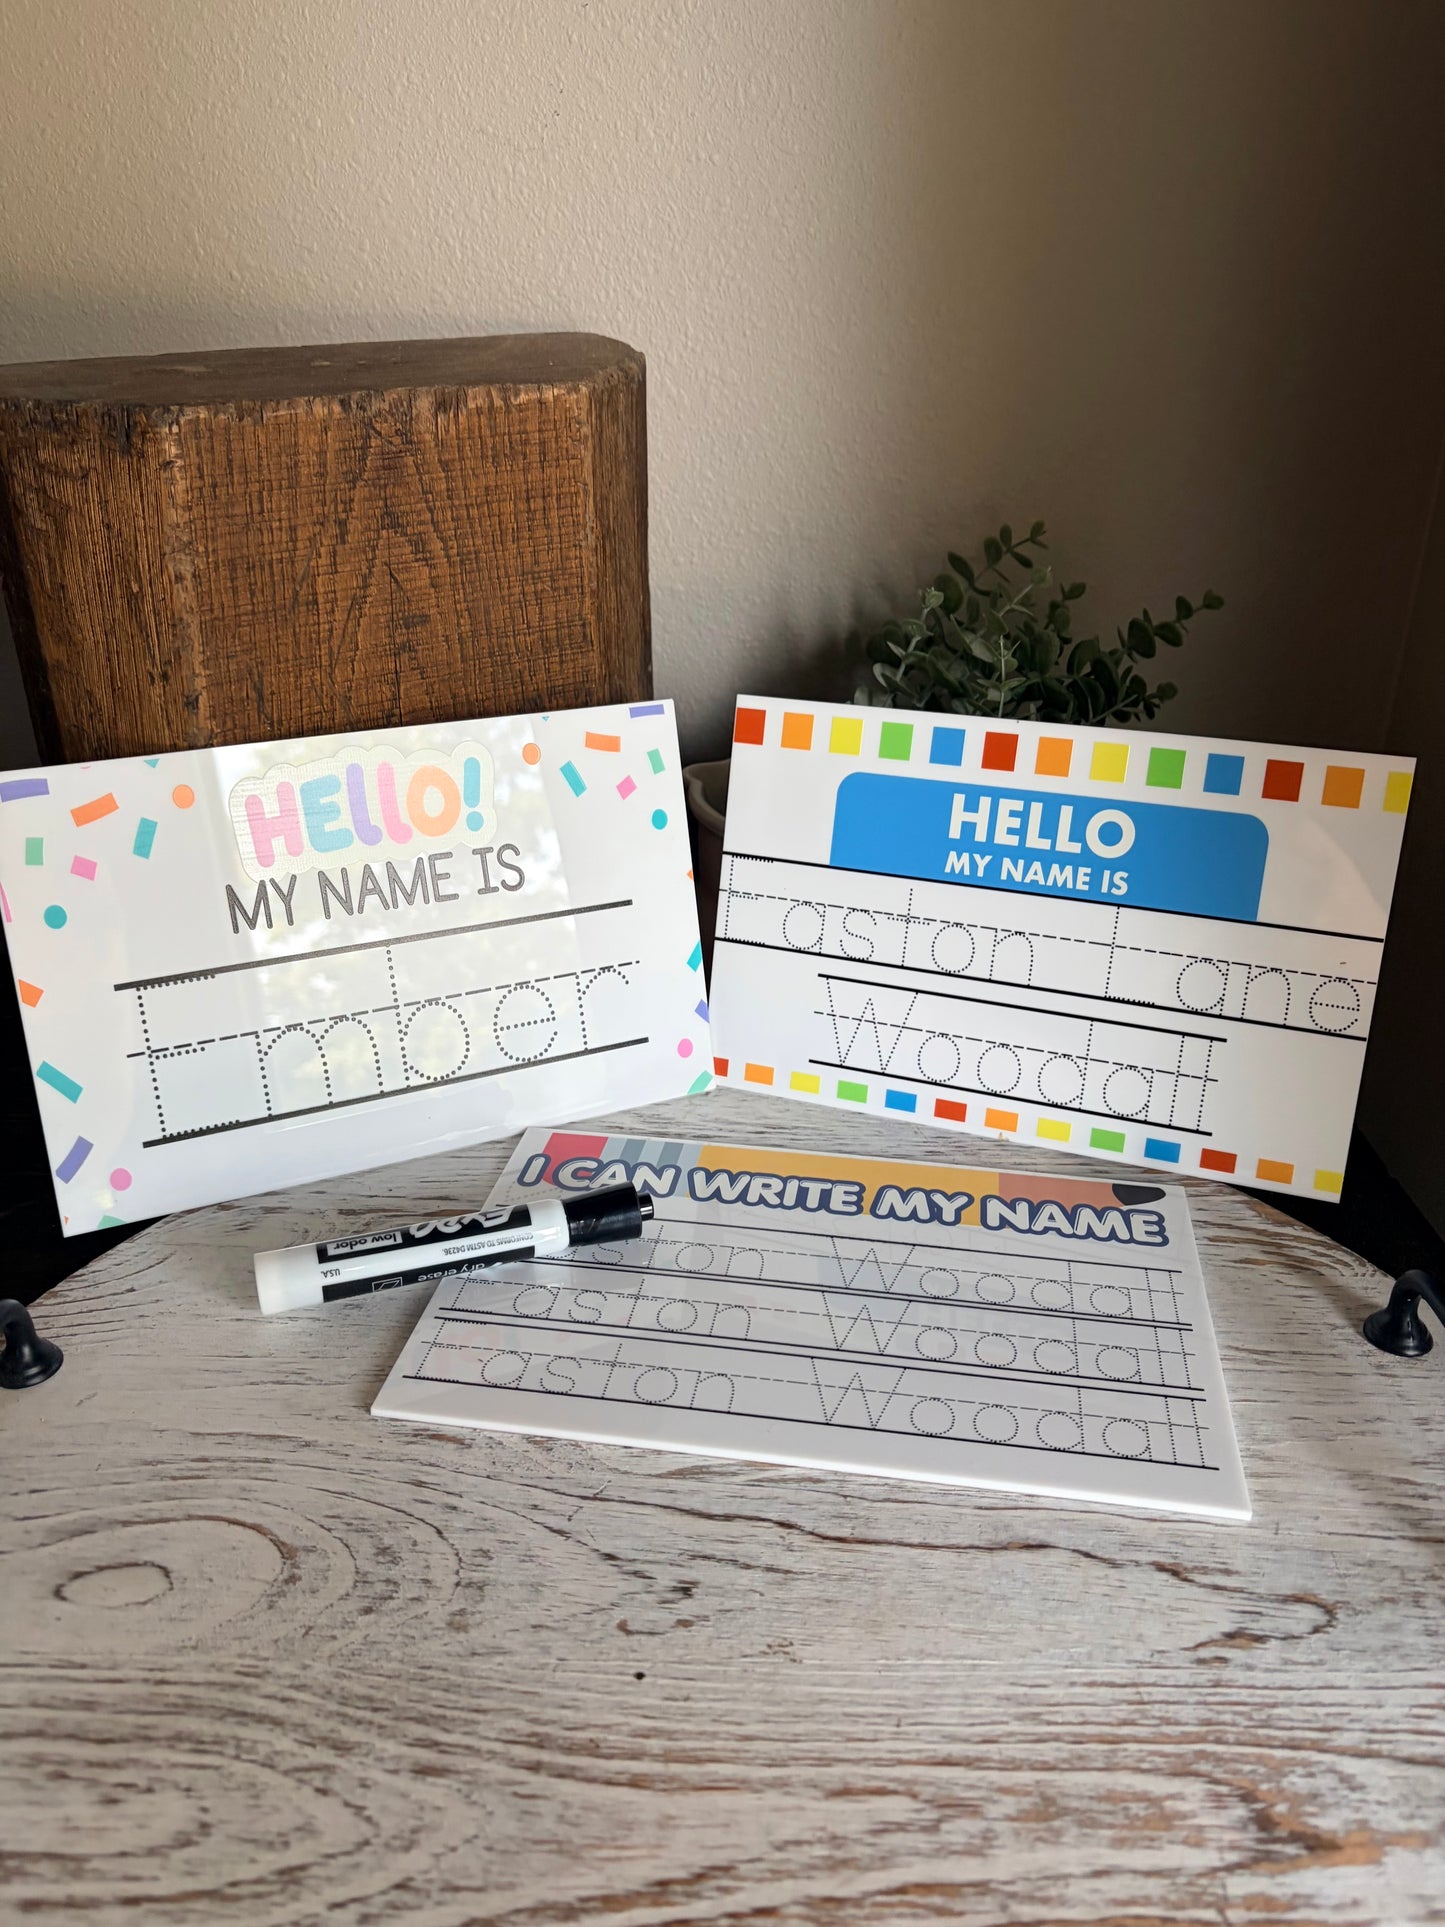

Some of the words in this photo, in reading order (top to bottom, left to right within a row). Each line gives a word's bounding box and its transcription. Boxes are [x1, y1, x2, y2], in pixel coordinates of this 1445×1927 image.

[948, 793, 1136, 858] HELLO
[225, 874, 297, 934] MY
[317, 851, 459, 919] NAME
[472, 843, 525, 895] IS
[944, 851, 993, 877] MY
[1000, 857, 1092, 891] NAME
[1101, 869, 1129, 896] IS
[724, 853, 1034, 986] Easton
[1104, 907, 1361, 1032] Lane
[136, 943, 630, 1138] Ember
[826, 976, 1213, 1133] Woodall
[333, 1238, 368, 1250] odor
[371, 1232, 397, 1247] low
[486, 1239, 497, 1247] TO
[519, 1154, 550, 1186] I
[554, 1157, 680, 1198] CAN
[690, 1166, 864, 1215] WRITE
[871, 1184, 972, 1225] MY
[980, 1195, 1168, 1246] NAME
[417, 1267, 458, 1282] erase
[466, 1241, 486, 1252] ASTM
[546, 1225, 764, 1280] ston
[831, 1236, 1180, 1324] Woodall
[822, 1290, 1192, 1389] Woodall
[415, 1318, 735, 1413] Easton
[811, 1356, 1205, 1467] Woodall
